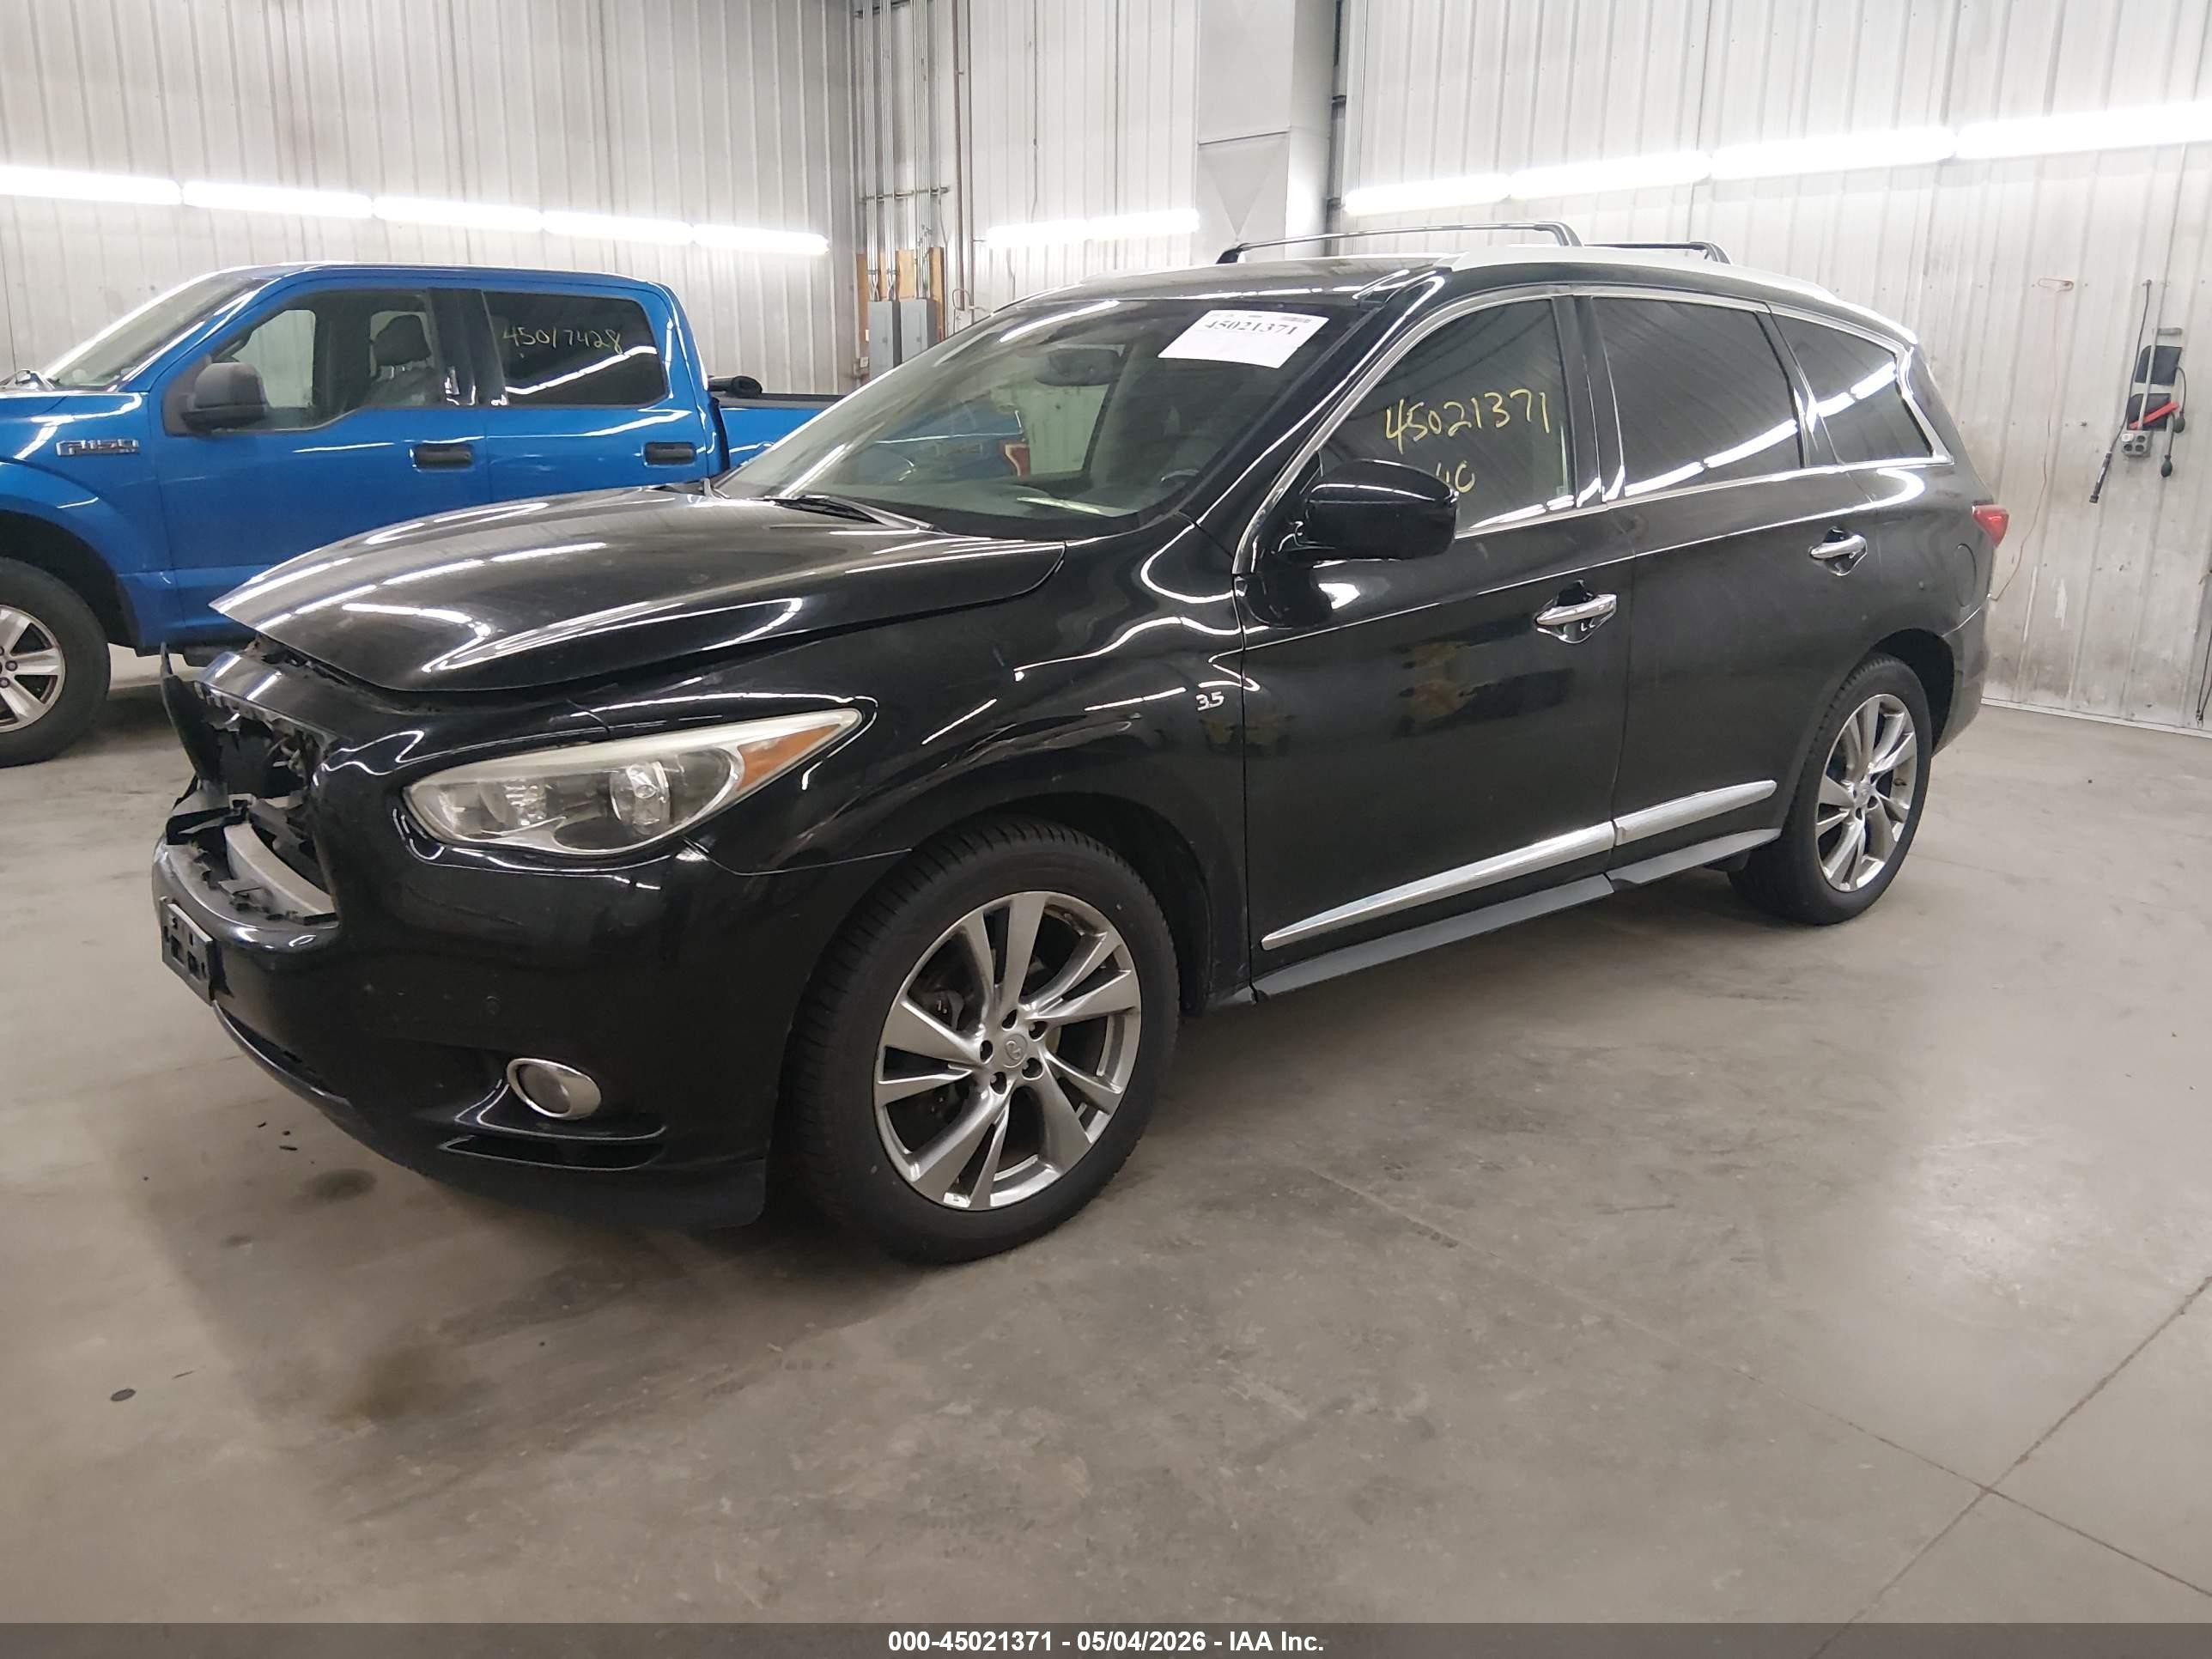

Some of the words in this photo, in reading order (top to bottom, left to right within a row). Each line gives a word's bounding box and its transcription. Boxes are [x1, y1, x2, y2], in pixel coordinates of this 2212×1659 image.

[502, 326, 623, 355] 45017428
[1205, 320, 1298, 336] 45021371
[1386, 389, 1550, 455] 45021371
